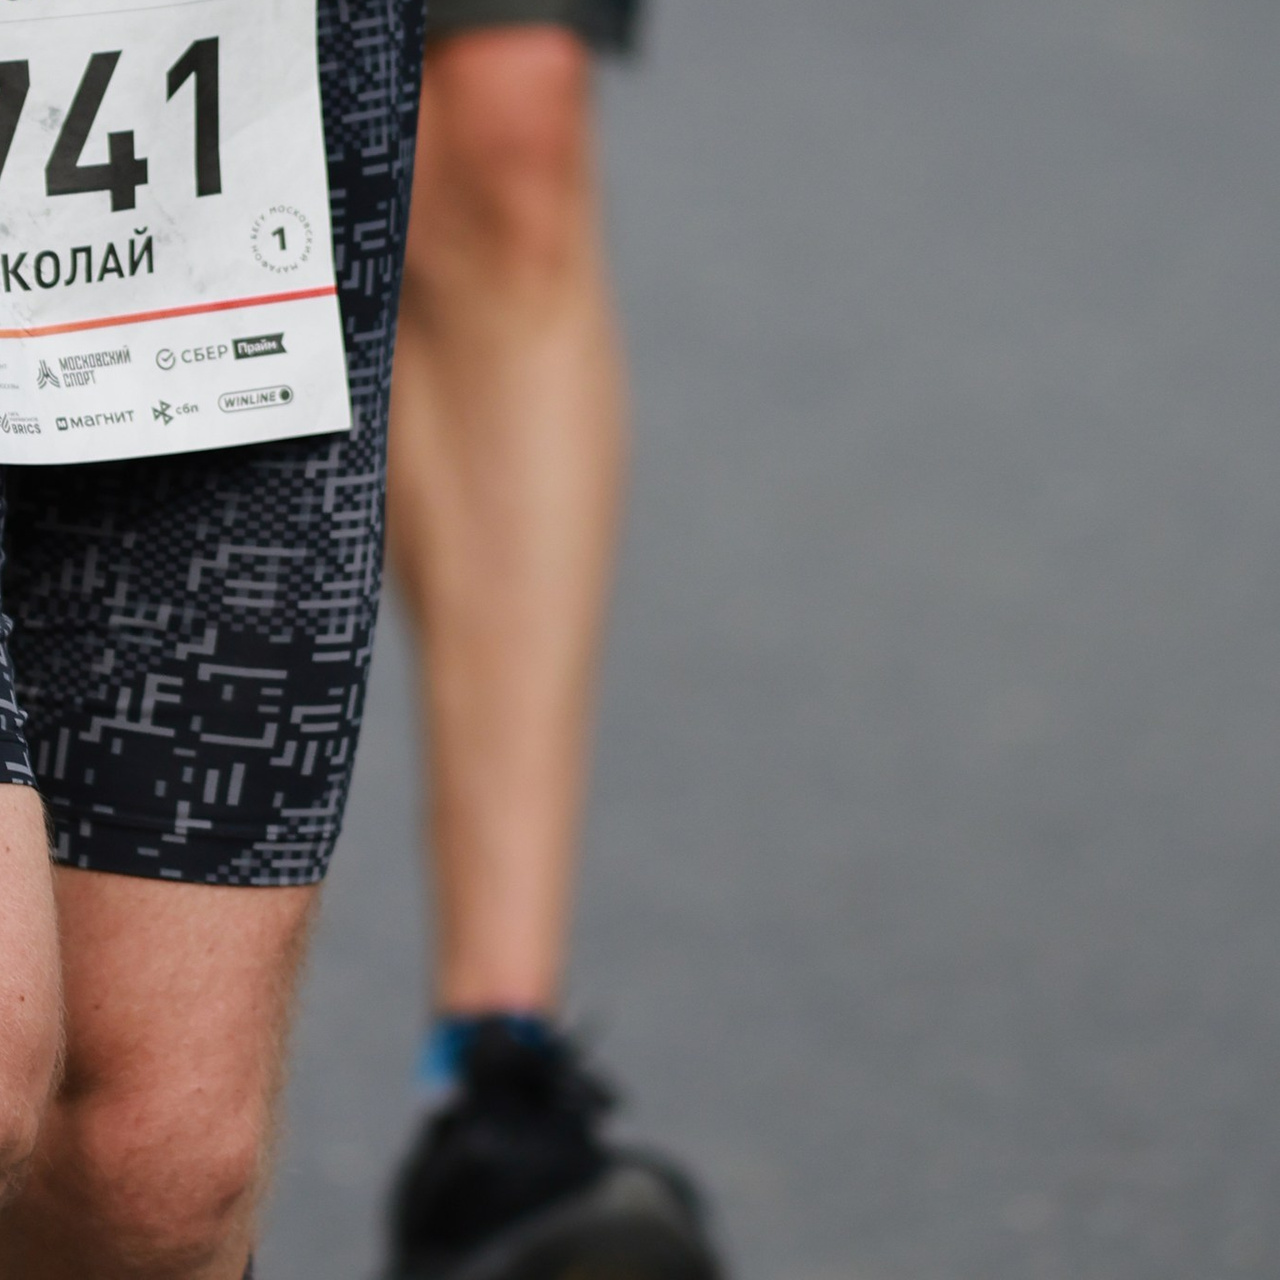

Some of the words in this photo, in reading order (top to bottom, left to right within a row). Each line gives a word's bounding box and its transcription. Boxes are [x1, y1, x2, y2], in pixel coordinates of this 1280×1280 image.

[271, 225, 287, 251] 1
[58, 344, 132, 372] МОСКОВСКИЙ
[180, 344, 229, 364] СБЕР
[236, 338, 278, 357] Прайм
[62, 370, 97, 389] СПОРТ
[223, 390, 277, 409] WINLINE
[11, 423, 42, 436] BRICS
